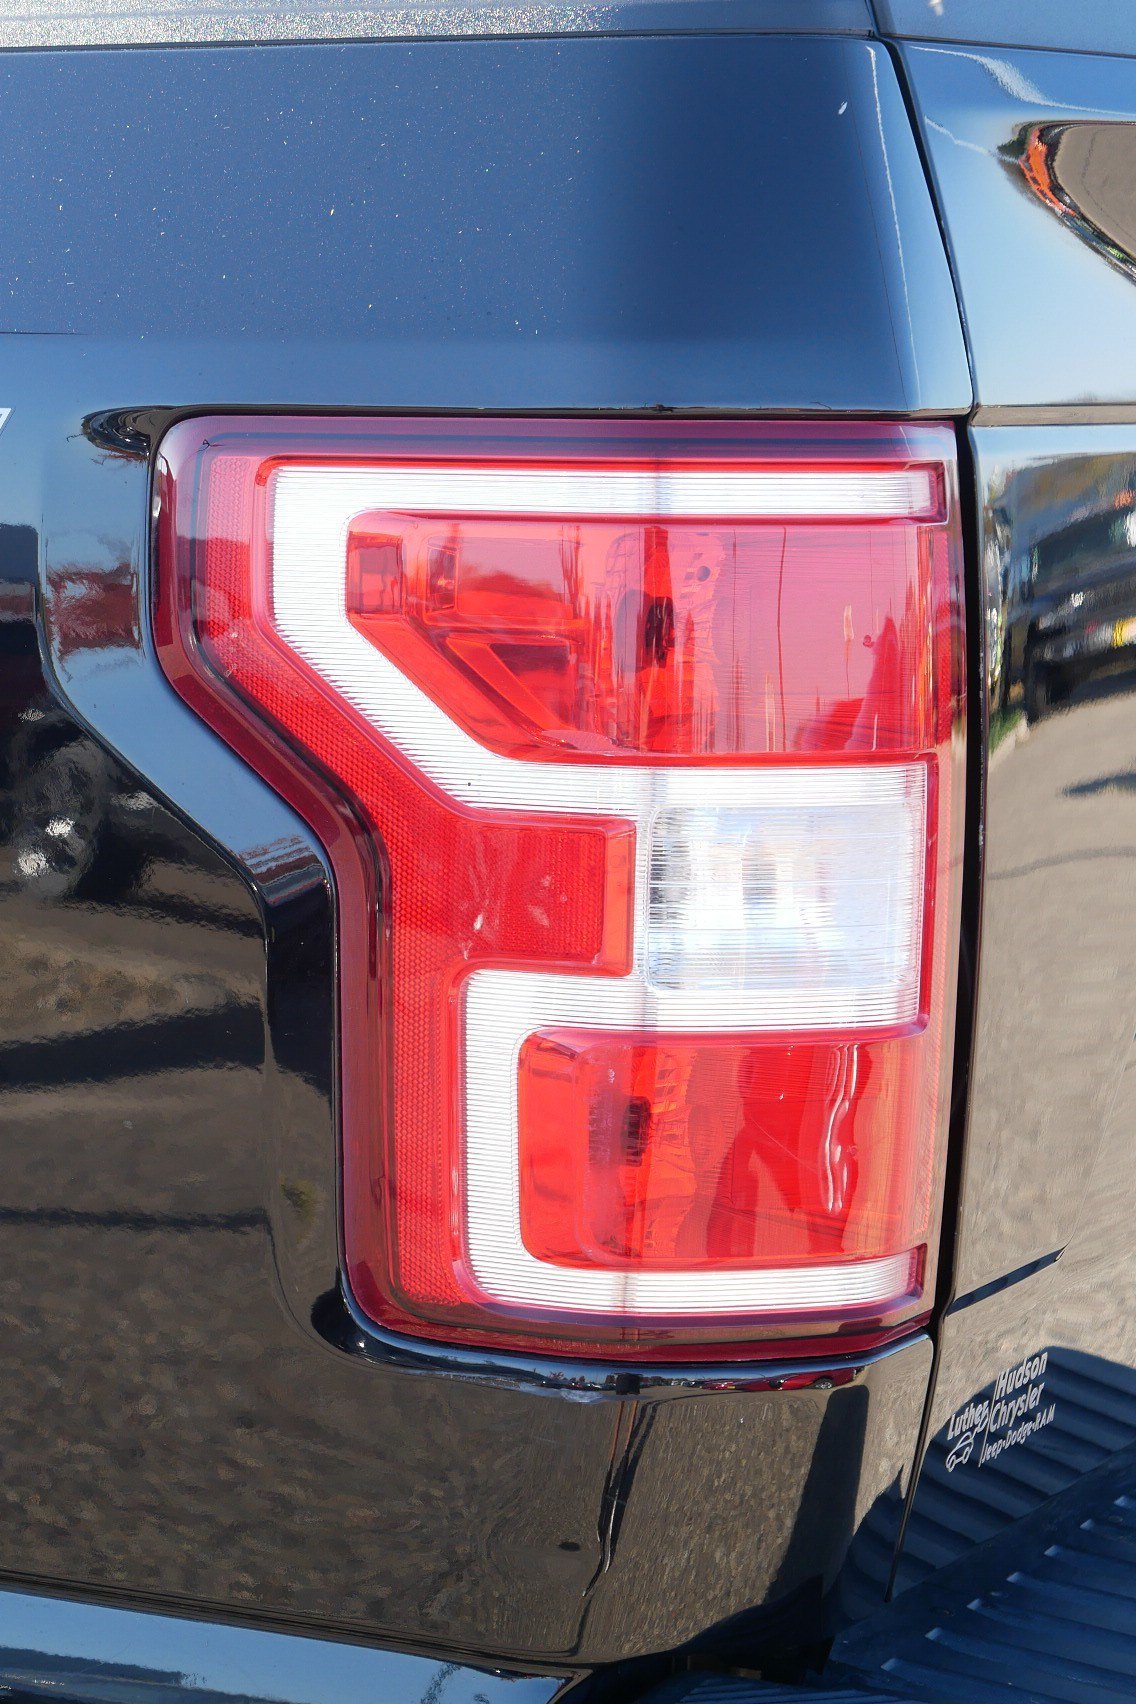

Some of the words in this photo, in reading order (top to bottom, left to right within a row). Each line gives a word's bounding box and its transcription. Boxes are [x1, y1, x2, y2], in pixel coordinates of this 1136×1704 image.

[995, 1351, 1048, 1401] Hudson
[947, 1400, 990, 1441] Luther
[989, 1382, 1045, 1433] Chrysler
